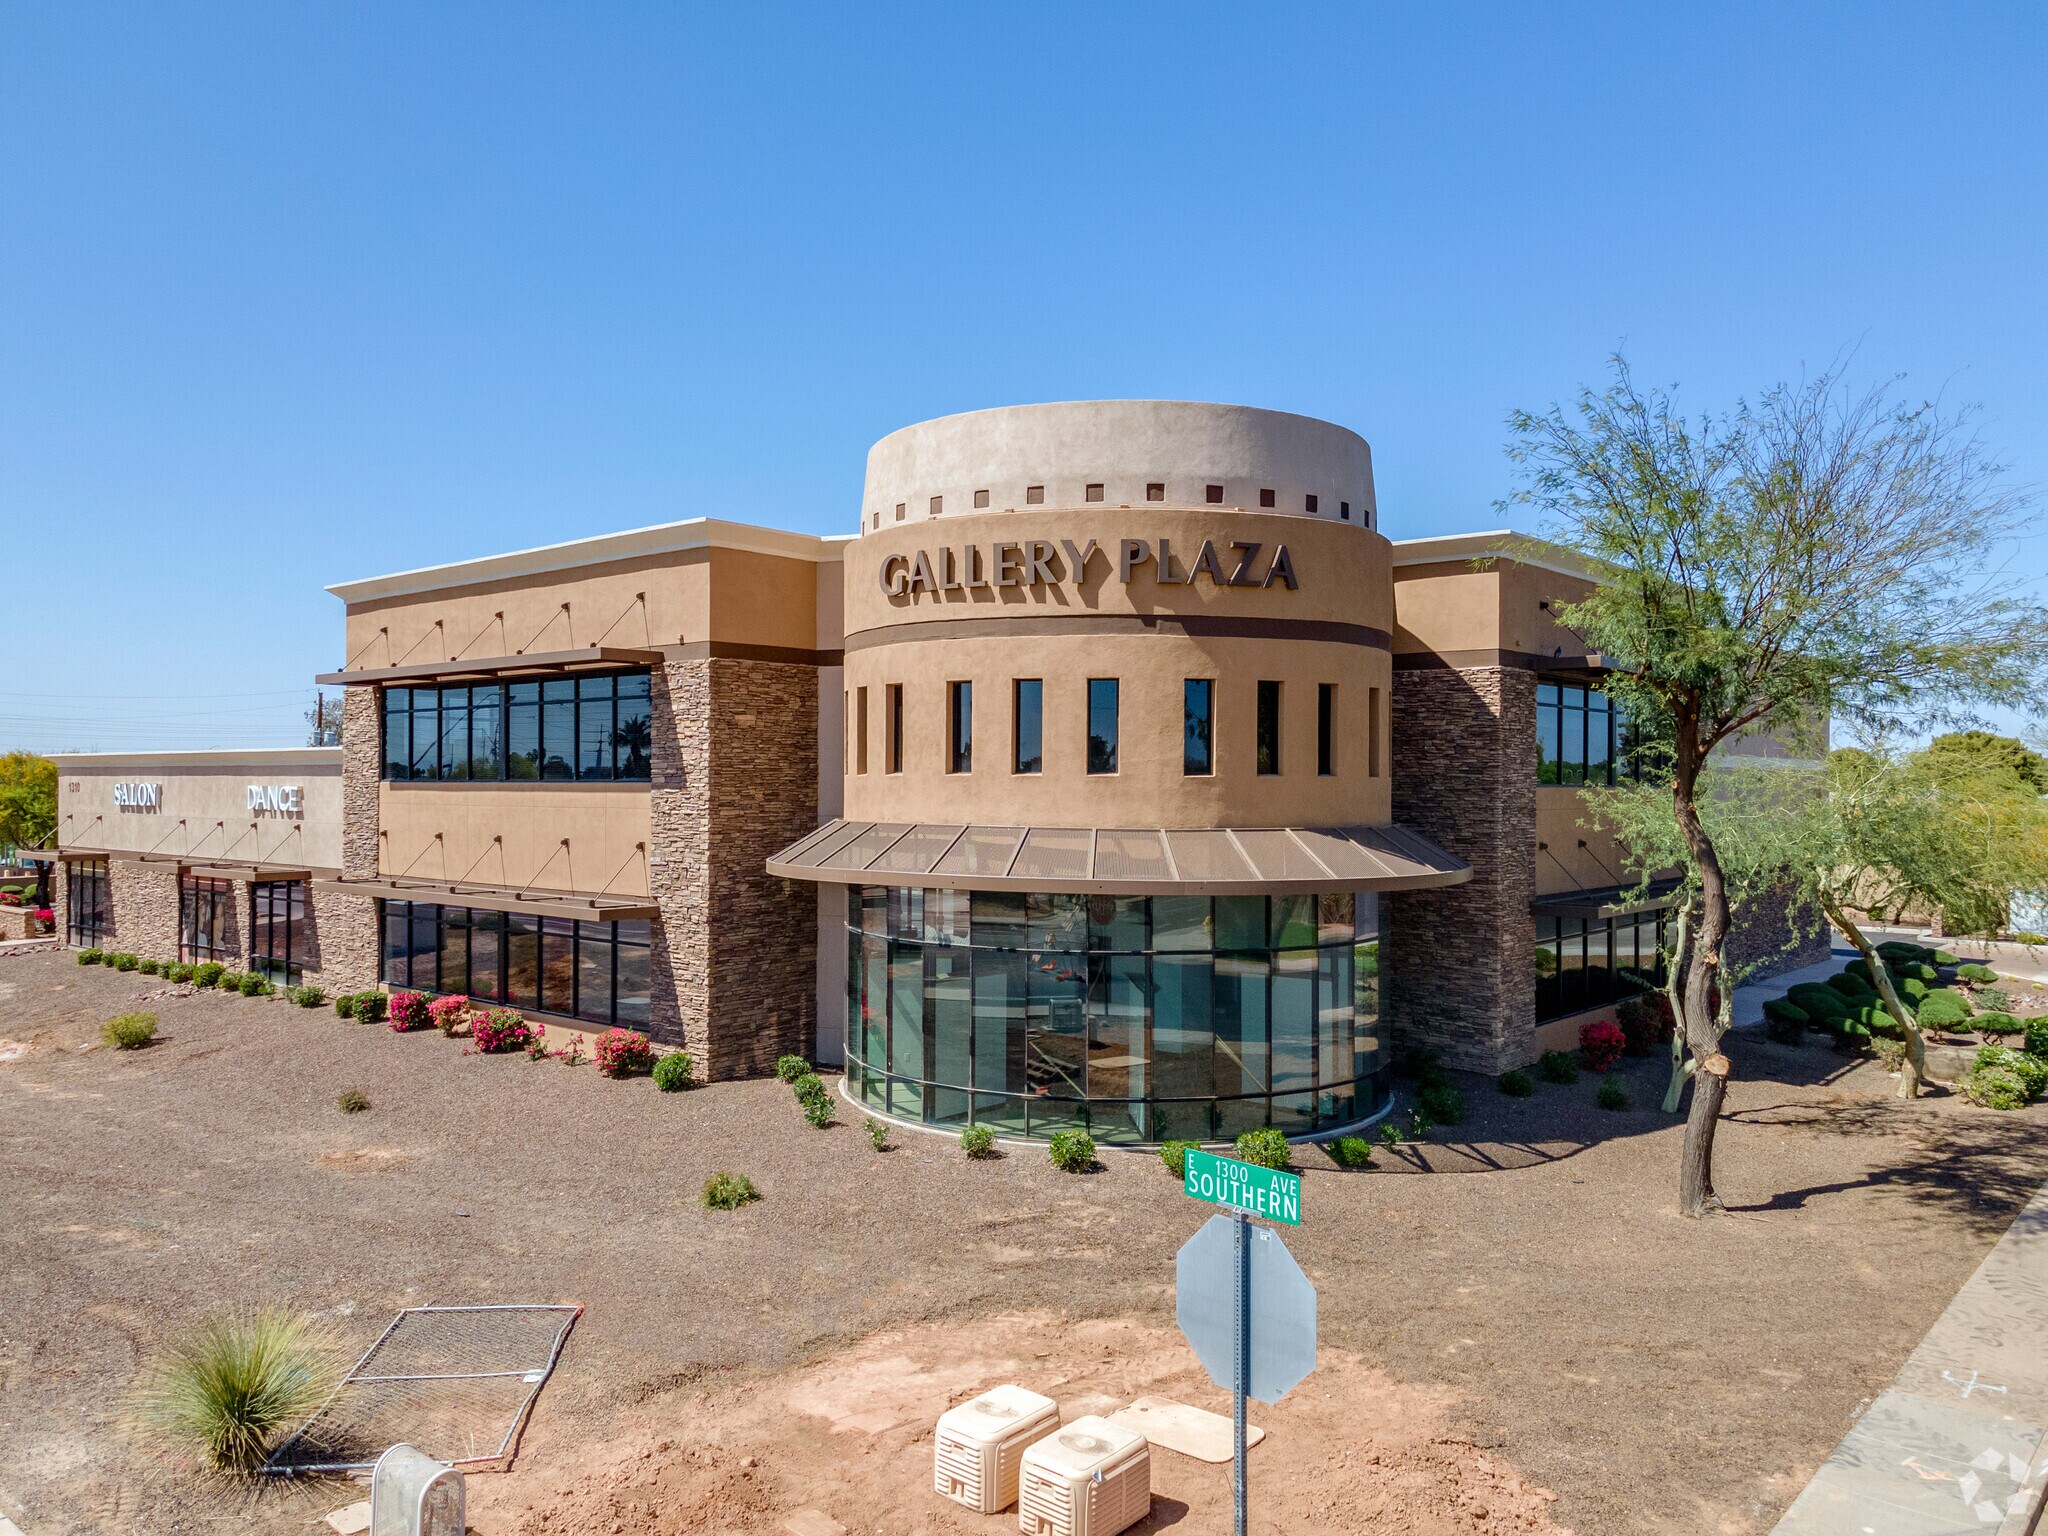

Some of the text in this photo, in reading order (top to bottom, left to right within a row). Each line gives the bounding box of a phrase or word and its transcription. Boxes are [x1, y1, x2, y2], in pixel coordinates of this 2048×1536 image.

[879, 538, 1298, 597] GALLERY PLAZA
[68, 782, 80, 793] 1310
[113, 783, 157, 806] SALON
[247, 785, 298, 812] DANCE
[1188, 1153, 1297, 1197] E 1300 AVE
[1188, 1170, 1297, 1221] SOUTHERN
